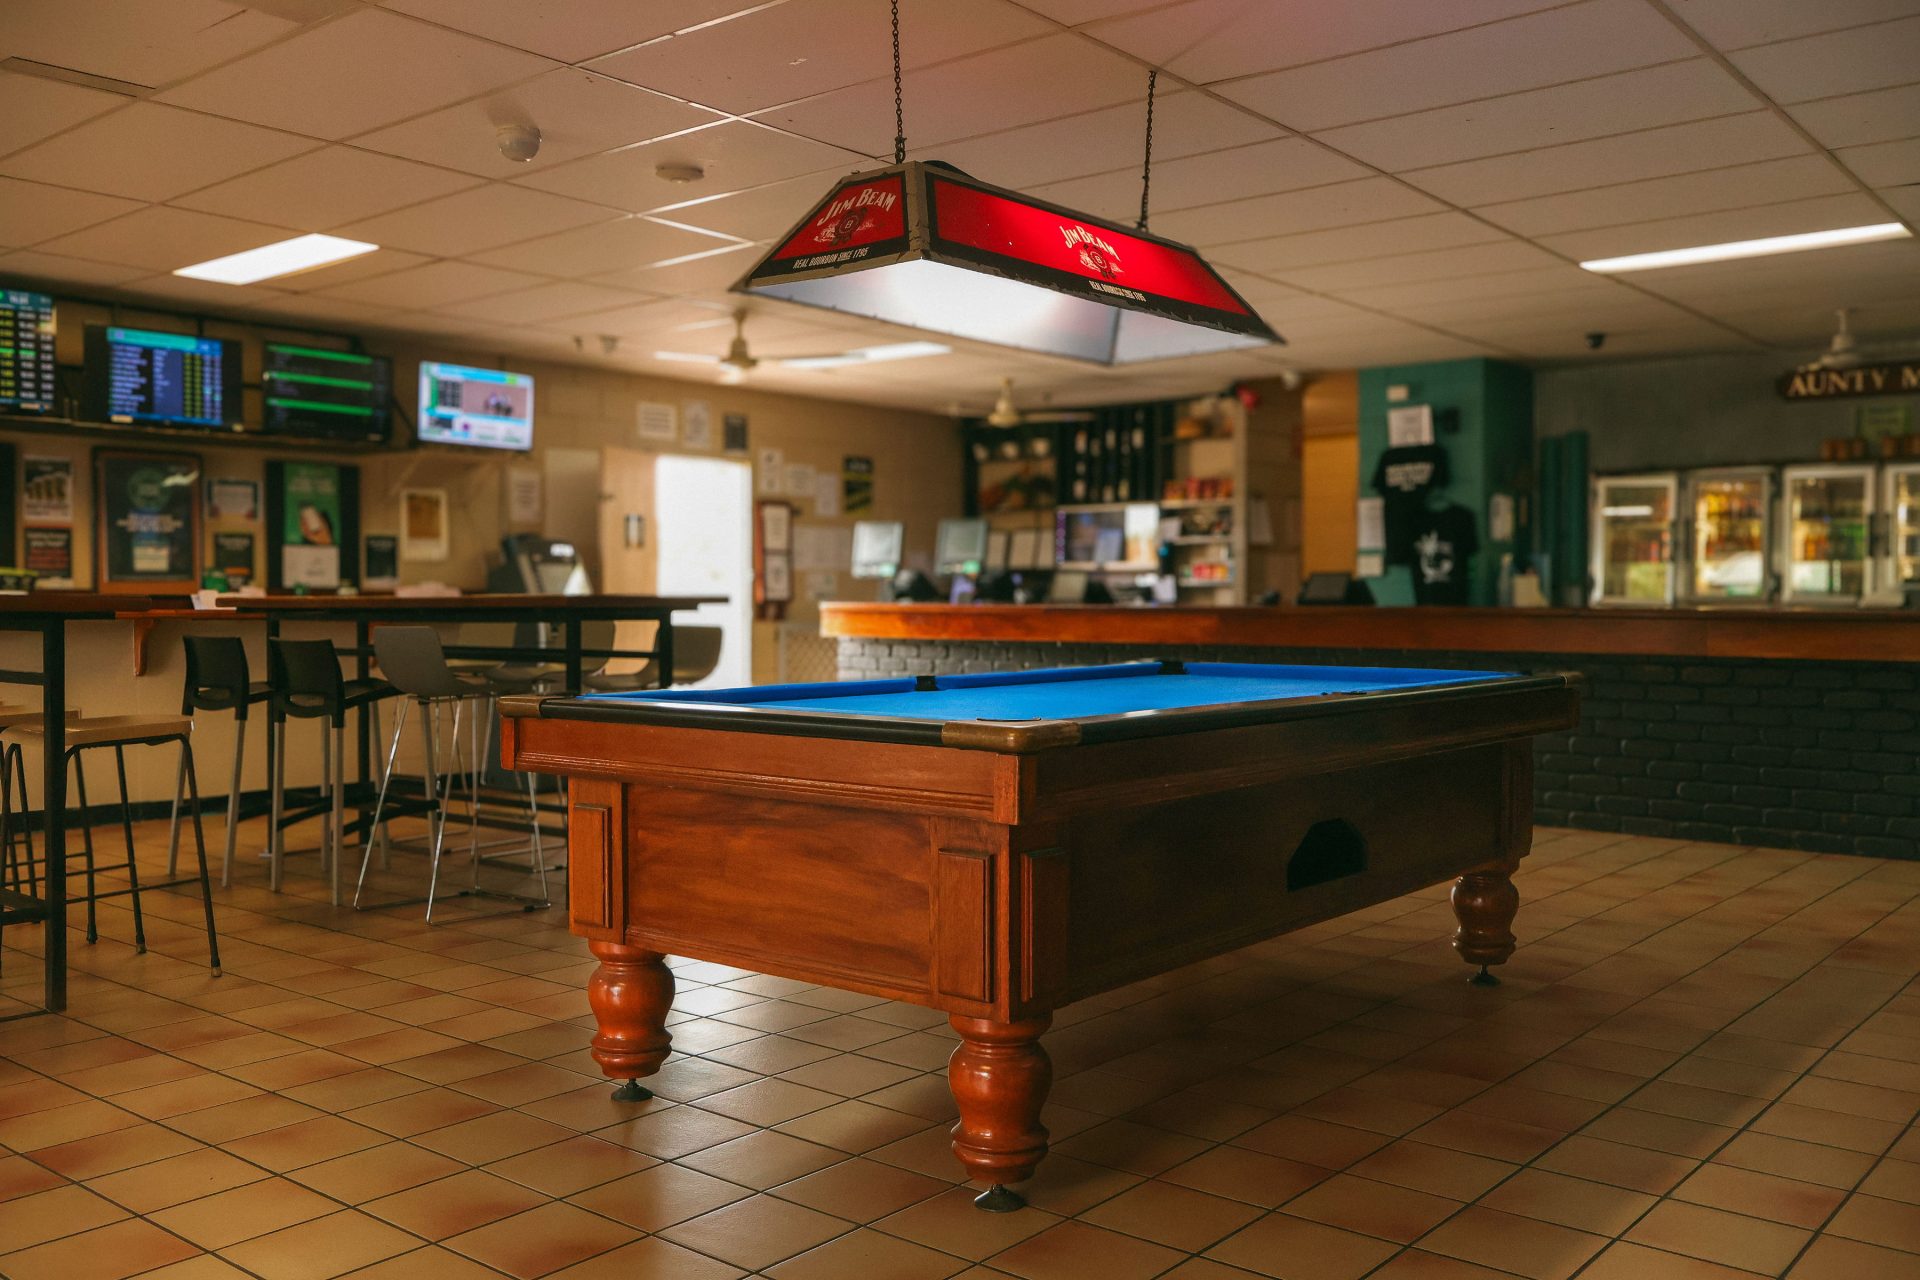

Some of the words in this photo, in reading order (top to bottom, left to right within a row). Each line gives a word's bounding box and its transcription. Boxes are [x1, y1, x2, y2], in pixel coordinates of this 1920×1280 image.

[817, 196, 856, 226] JIM
[856, 188, 896, 212] BEAM
[1060, 226, 1081, 248] JIM
[1075, 226, 1121, 261] BEAM
[793, 259, 809, 269] REAL
[1787, 368, 1888, 397] AUNTY
